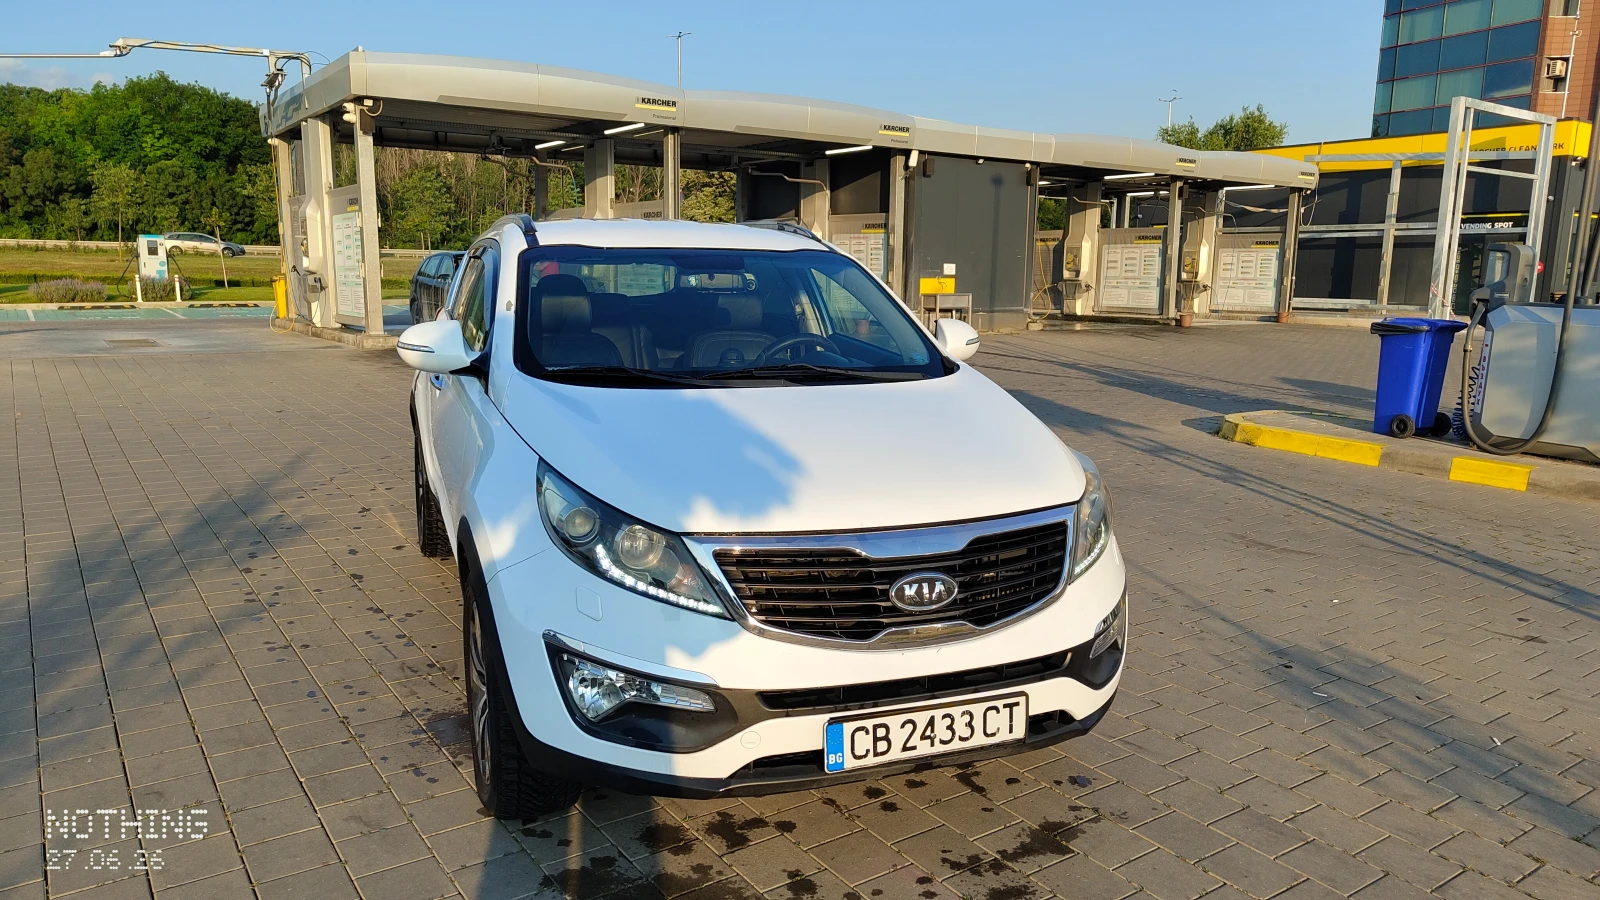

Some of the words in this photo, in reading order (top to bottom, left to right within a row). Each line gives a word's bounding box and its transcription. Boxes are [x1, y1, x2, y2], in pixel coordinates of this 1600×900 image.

[641, 97, 677, 107] KÄRCHER
[1461, 222, 1493, 230] VENDING
[1494, 221, 1514, 229] SPOT
[902, 581, 948, 602] KIA
[850, 722, 892, 761] CB
[899, 709, 975, 753] 2433
[982, 701, 1020, 738] CT
[828, 752, 843, 765] BG
